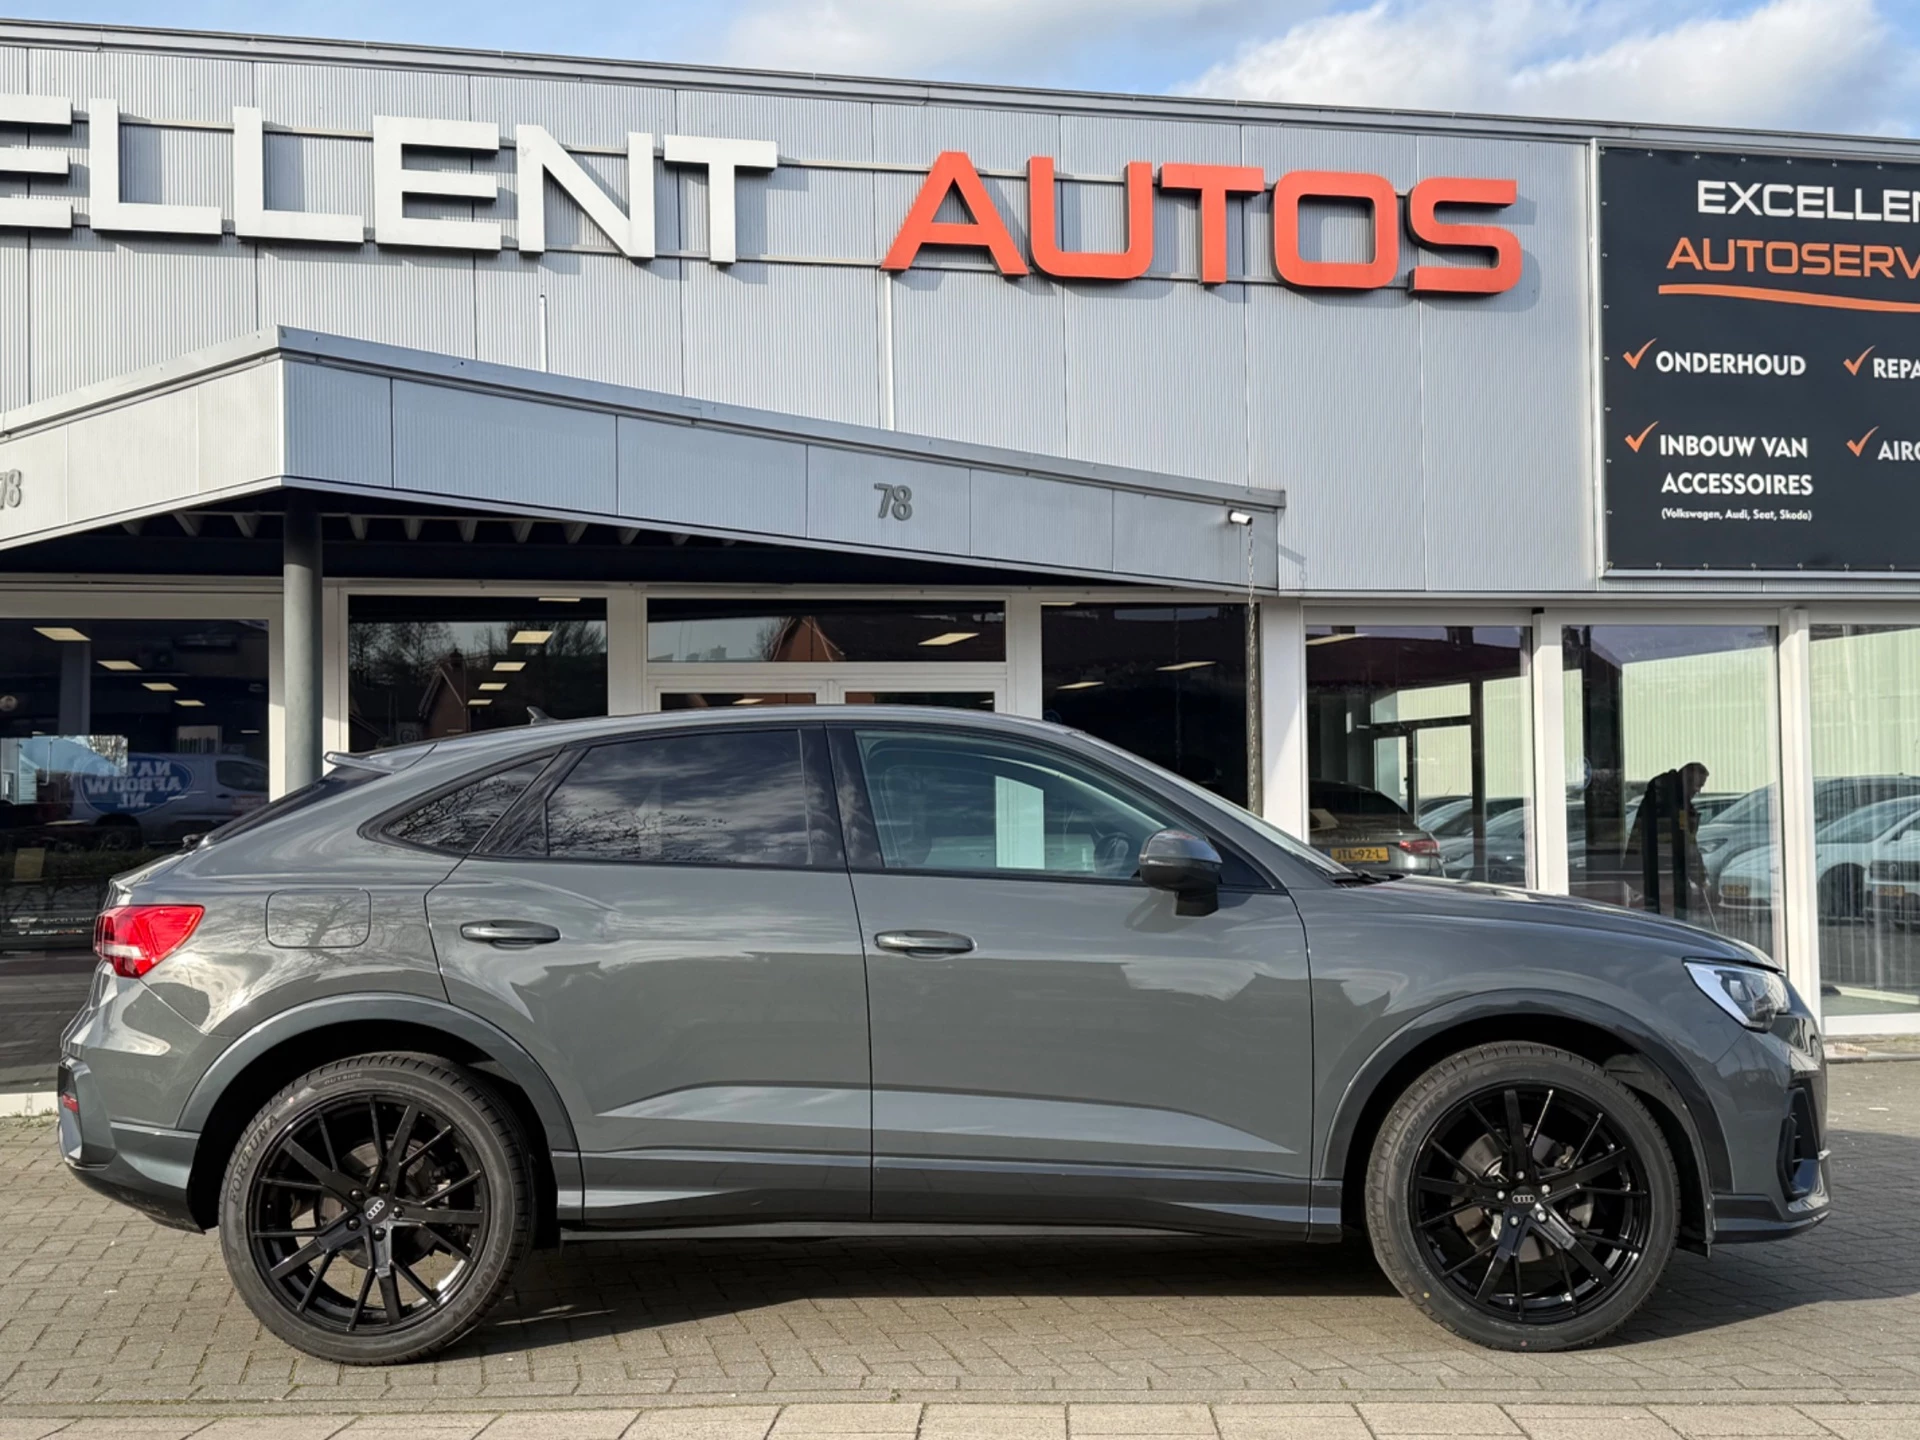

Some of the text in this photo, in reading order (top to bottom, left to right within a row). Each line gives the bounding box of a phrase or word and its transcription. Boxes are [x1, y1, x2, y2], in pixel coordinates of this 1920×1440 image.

[1697, 179, 1920, 224] EXCELLE
[880, 151, 1523, 295] AUTOS
[1666, 236, 1920, 280] AUTOSERV
[1655, 350, 1807, 376] ONDERHOUD
[1660, 434, 1808, 458] INBOUW VAN
[873, 482, 913, 521] 78
[1661, 472, 1814, 496] ACCESSOIRES
[1661, 508, 1813, 522] (Volkswagen, Audi, Seat, Skoda)
[229, 1113, 281, 1205] FORTUNA
